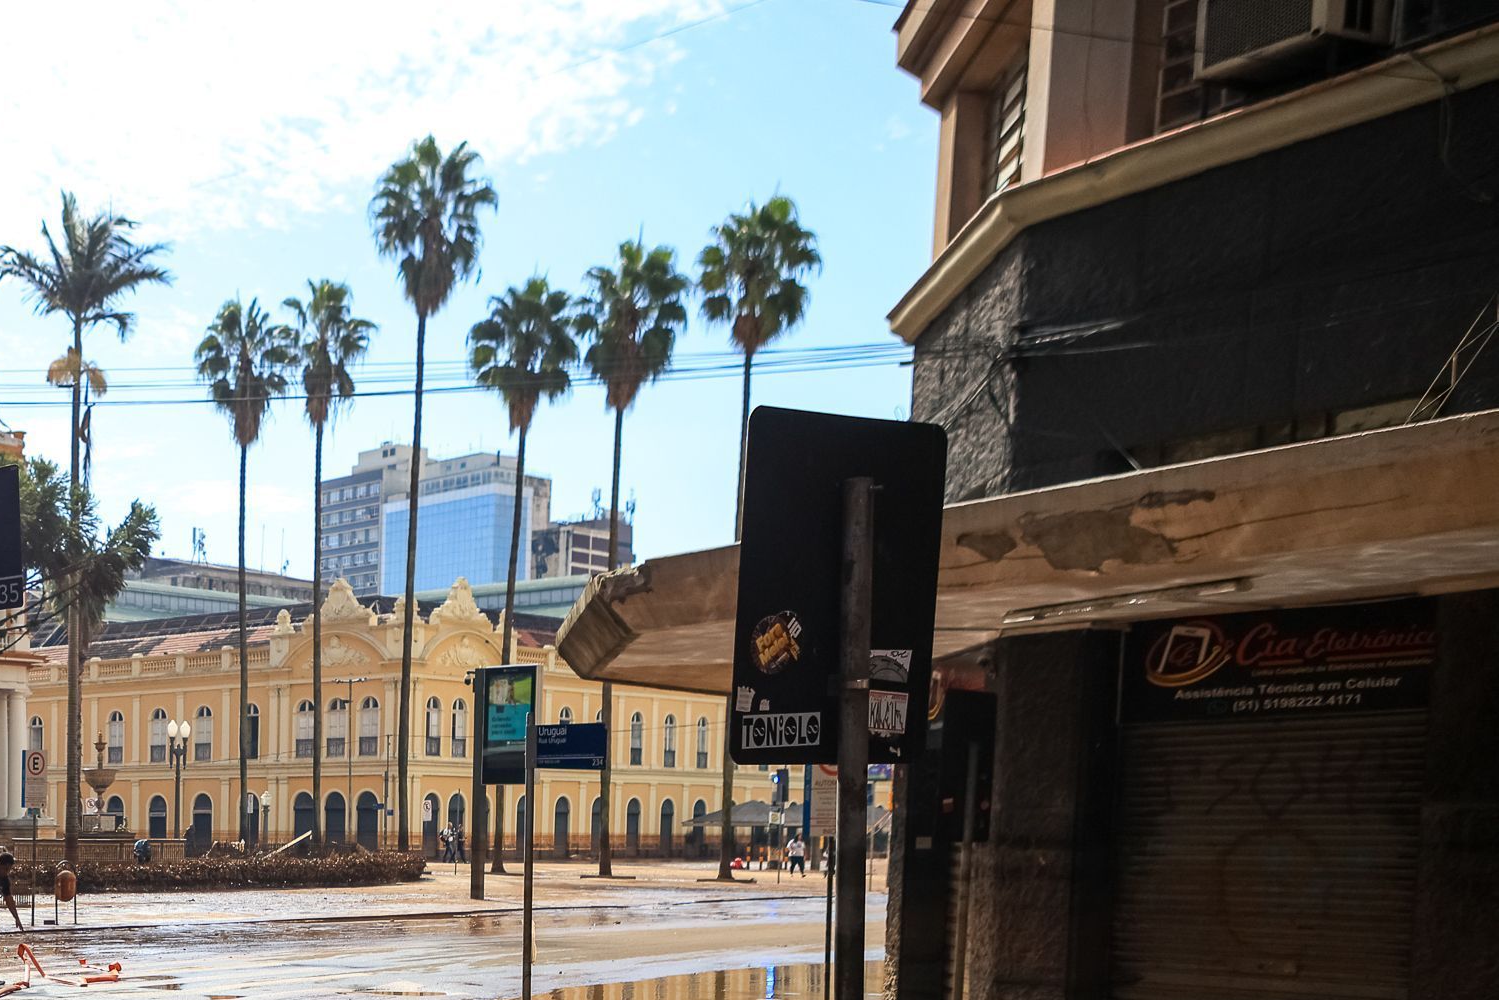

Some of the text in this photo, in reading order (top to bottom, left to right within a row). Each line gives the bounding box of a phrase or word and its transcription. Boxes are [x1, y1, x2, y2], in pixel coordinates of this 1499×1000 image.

[1236, 622, 1299, 667] Cia
[1174, 676, 1402, 700] Assistência Técnica em Celular
[1233, 699, 1260, 713] (51)
[538, 726, 567, 737] Uruguai
[32, 757, 40, 770] E
